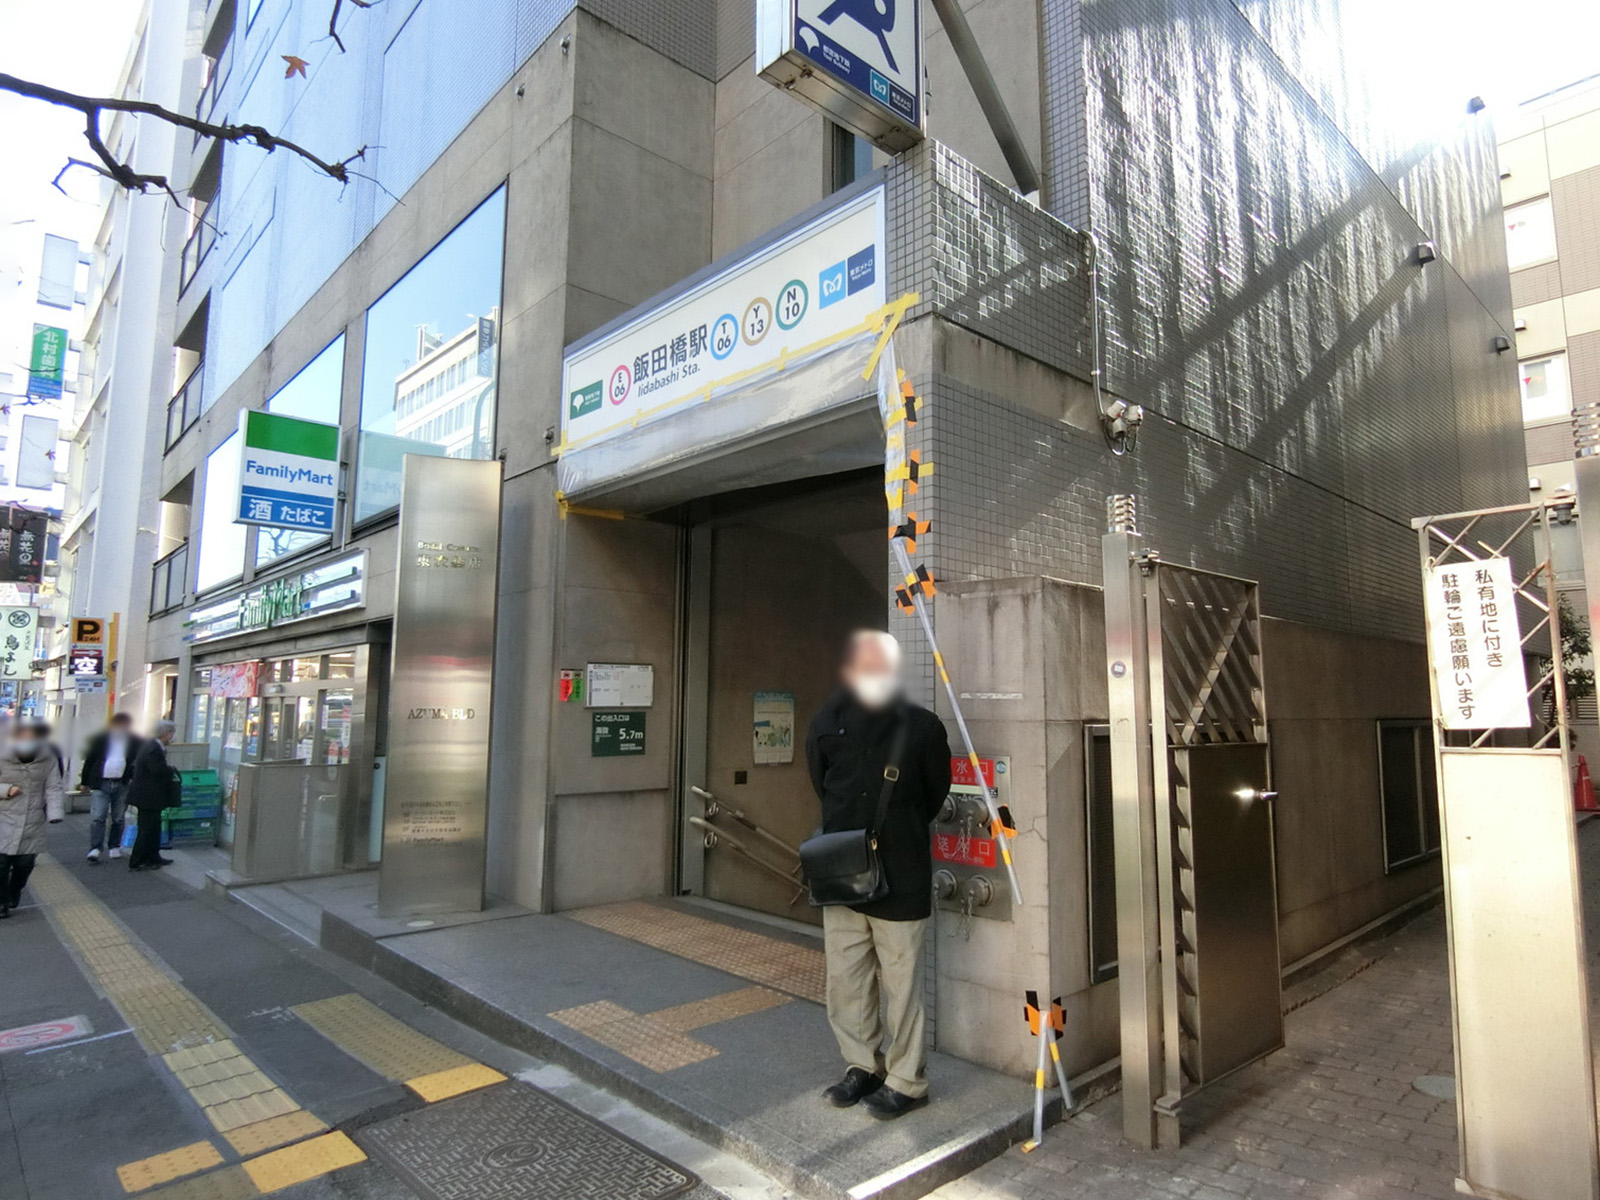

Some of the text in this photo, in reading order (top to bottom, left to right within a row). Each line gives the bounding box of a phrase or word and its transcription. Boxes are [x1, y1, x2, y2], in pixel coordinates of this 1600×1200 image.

[787, 287, 797, 303] N
[753, 305, 761, 319] Y
[785, 302, 800, 320] 10
[721, 321, 728, 335] T
[750, 319, 764, 336] 13
[717, 335, 731, 352] 06
[633, 324, 708, 384] 飯田橋駅
[618, 372, 623, 383] E
[637, 363, 701, 398] Iidabashi Sta.
[614, 384, 626, 398] 06
[246, 460, 333, 486] FamilyMart
[248, 498, 325, 525] 酒 たばこ
[236, 575, 303, 630] FamilyMart
[1475, 568, 1503, 668] 私有地に付き
[77, 620, 100, 641] P
[1441, 573, 1476, 720] 駐輪ご遠慮願います
[74, 656, 98, 674] 空
[618, 727, 644, 740] 5.7m
